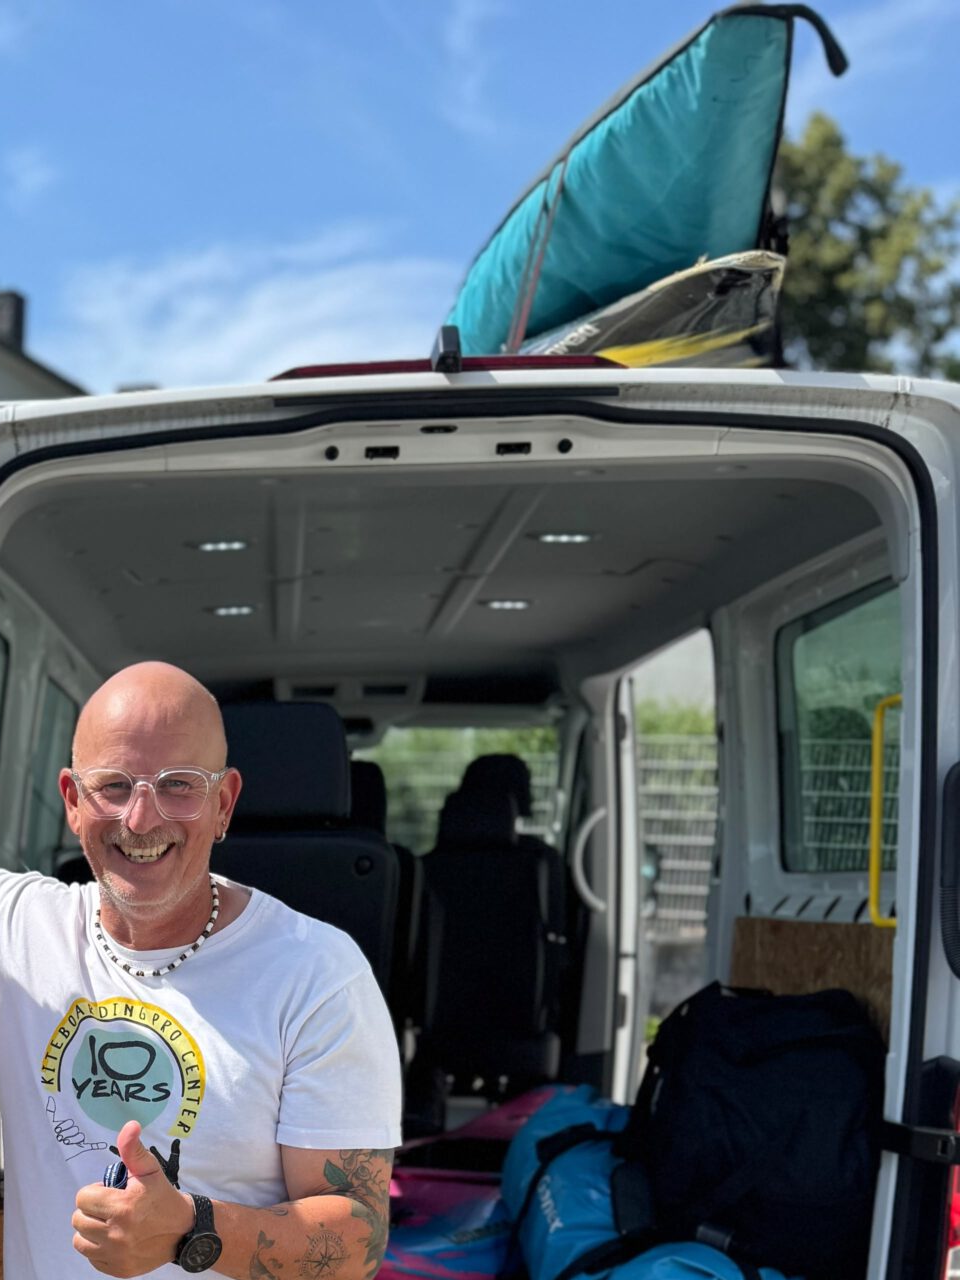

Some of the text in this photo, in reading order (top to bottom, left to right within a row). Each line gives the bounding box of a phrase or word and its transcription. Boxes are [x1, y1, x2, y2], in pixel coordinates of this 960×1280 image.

[88, 1035, 157, 1081] 10
[72, 1077, 171, 1102] YEARS
[177, 1050, 201, 1133] CENTER
